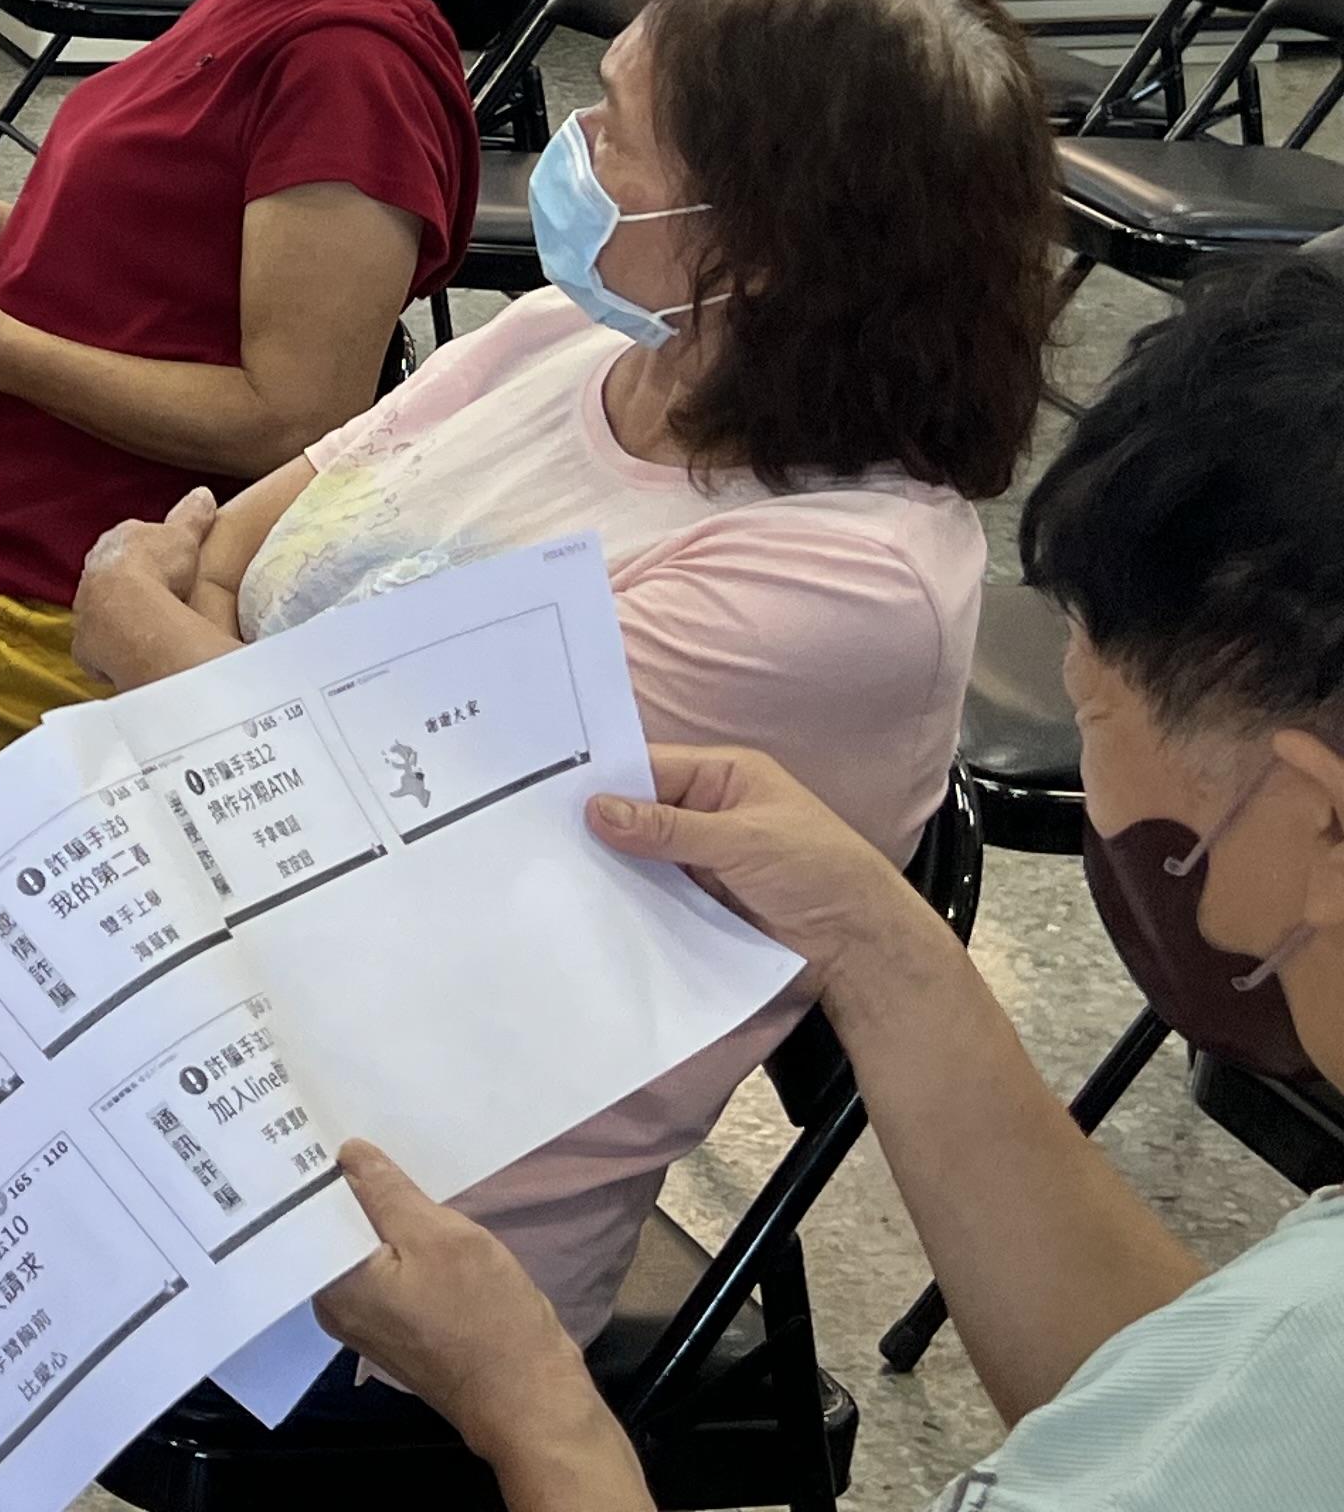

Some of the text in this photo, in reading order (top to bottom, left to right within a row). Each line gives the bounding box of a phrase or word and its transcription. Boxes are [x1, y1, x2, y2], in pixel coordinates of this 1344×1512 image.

[43, 814, 130, 878] 詐騙手法9
[48, 843, 152, 919] 我的第二春
[152, 1107, 243, 1208] 通訊詐騙
[18, 1350, 69, 1402] 比愛心
